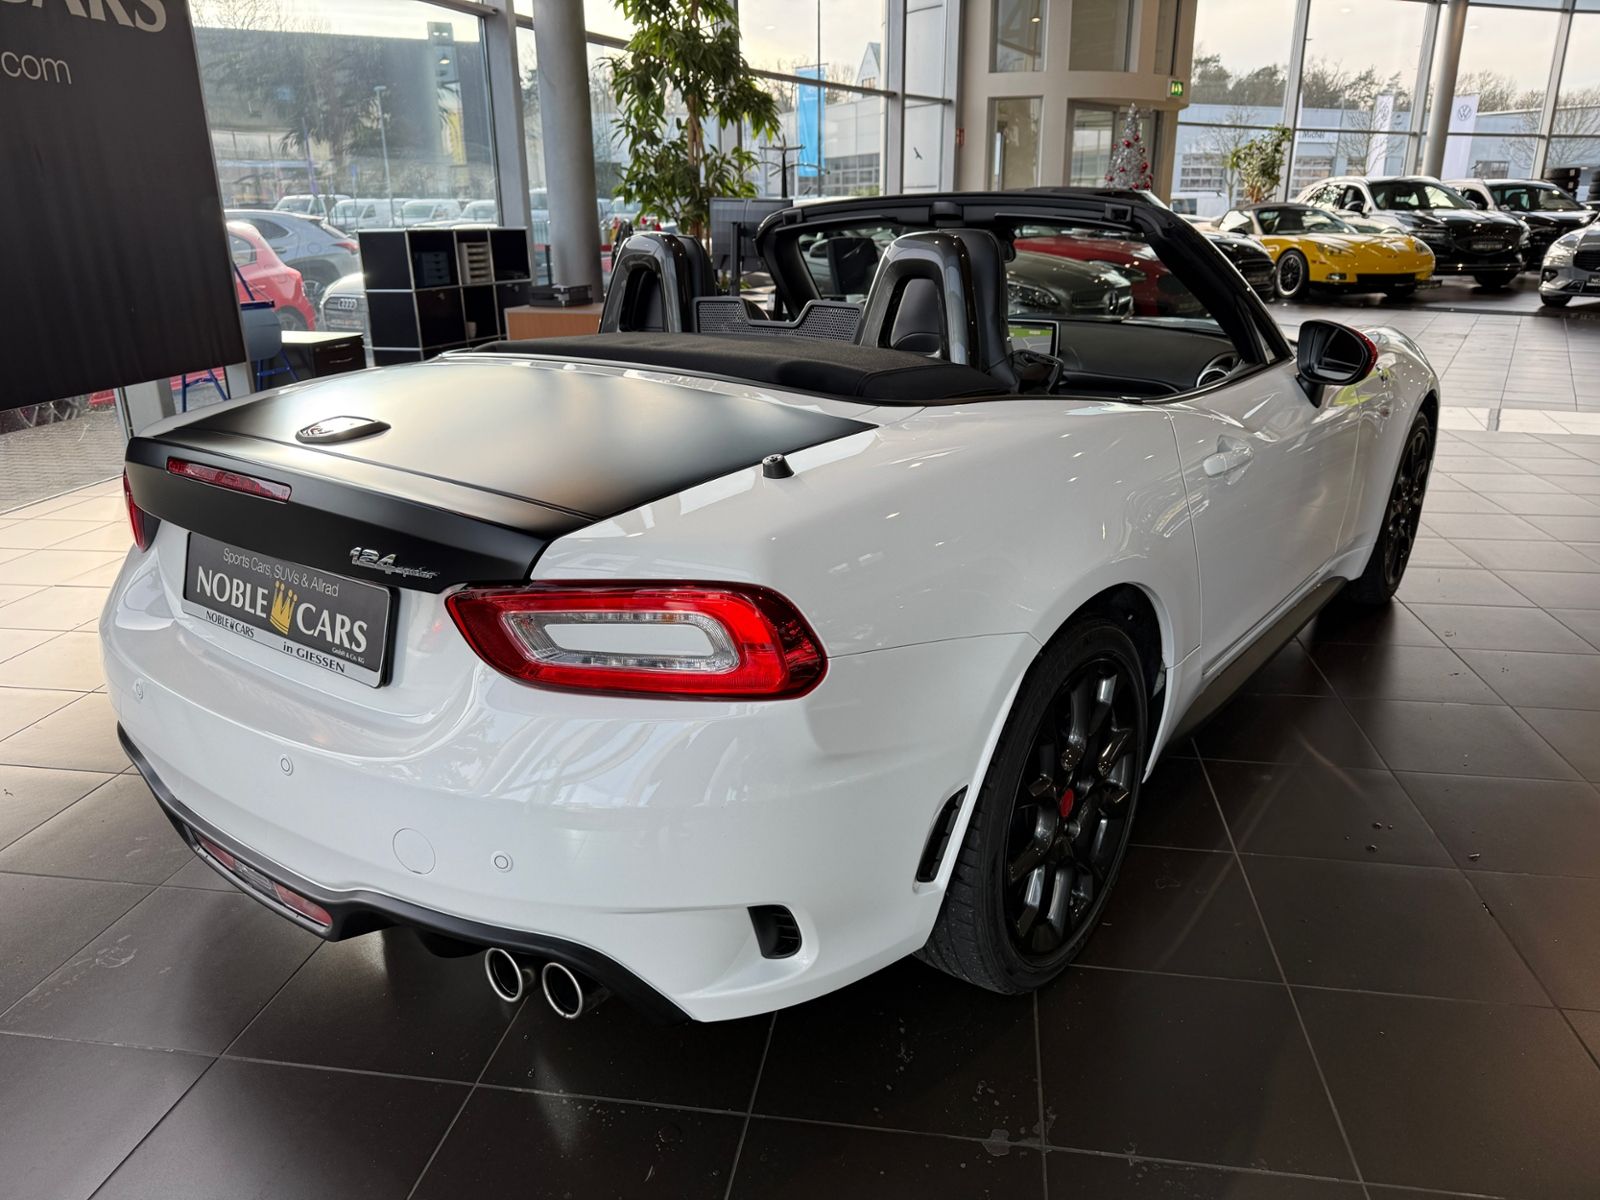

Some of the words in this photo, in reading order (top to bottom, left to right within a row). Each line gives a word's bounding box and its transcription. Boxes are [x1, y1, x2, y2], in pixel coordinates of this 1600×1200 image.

[223, 548, 250, 569] Sports
[250, 557, 273, 577] Cars,
[273, 564, 300, 585] SUVs
[300, 573, 309, 588] &
[310, 576, 340, 597] Allrad
[349, 547, 396, 574] 124
[196, 565, 269, 619] NOBLE
[296, 602, 368, 653] CARS
[205, 610, 230, 628] NOBLE
[234, 622, 255, 638] CARS
[283, 641, 293, 654] in
[296, 647, 345, 673] GIESSEN
